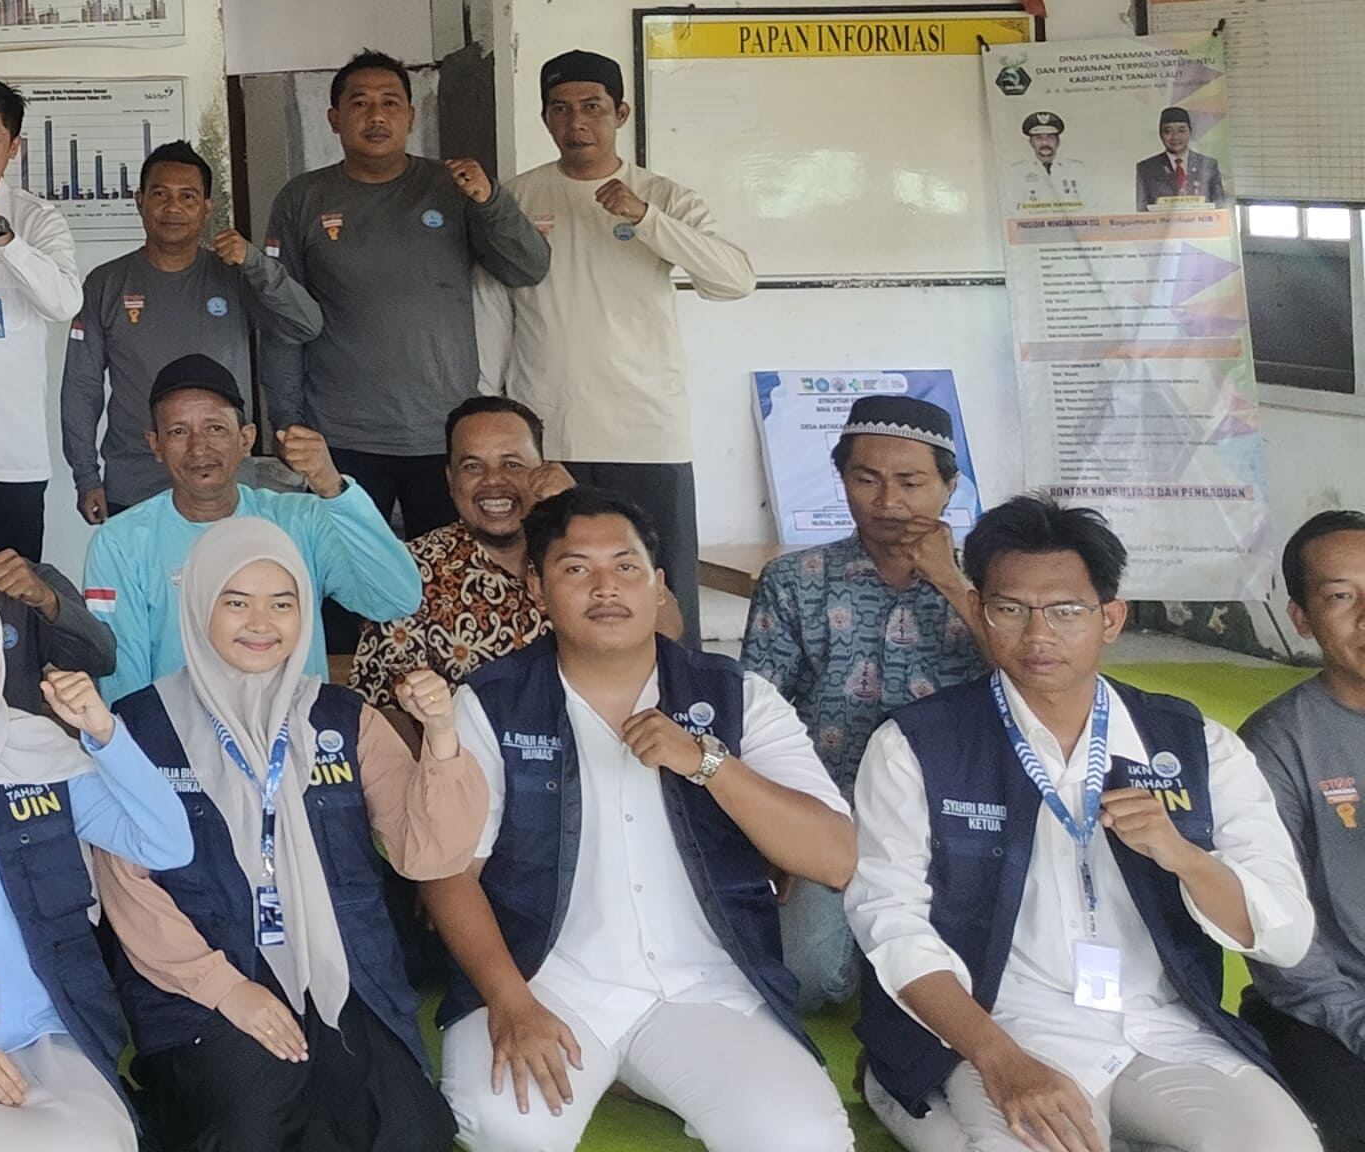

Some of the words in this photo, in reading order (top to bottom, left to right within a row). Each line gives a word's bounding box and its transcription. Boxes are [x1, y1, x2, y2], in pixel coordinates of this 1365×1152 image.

[739, 24, 809, 54] PAPAN
[818, 23, 945, 53] INFORMASI
[1059, 54, 1088, 64] DINAS
[1090, 51, 1151, 62] PENANAMAN
[1154, 48, 1189, 59] MODAL
[1036, 66, 1056, 77] DAN
[1057, 63, 1111, 75] PELAYANAN
[1116, 60, 1159, 72] TERPADU
[1069, 73, 1123, 85] KABUPATEN
[1124, 71, 1158, 82] TANAH
[1159, 70, 1184, 80] LAUT
[1050, 486, 1089, 498] KONTAK
[1091, 485, 1155, 498] KONSULTASI
[1157, 486, 1179, 498] DAN
[1181, 486, 1246, 498] PENGADUAN
[338, 751, 345, 762] 1
[521, 748, 554, 761] HUMAS
[310, 761, 354, 786] UIN
[1130, 777, 1173, 789] TAHAP
[1174, 776, 1183, 788] 1
[1318, 777, 1356, 791] STOP
[6, 785, 44, 802] TAHAP
[1153, 788, 1193, 812] IN
[9, 791, 62, 821] UIN
[968, 817, 1002, 832] KETUA
